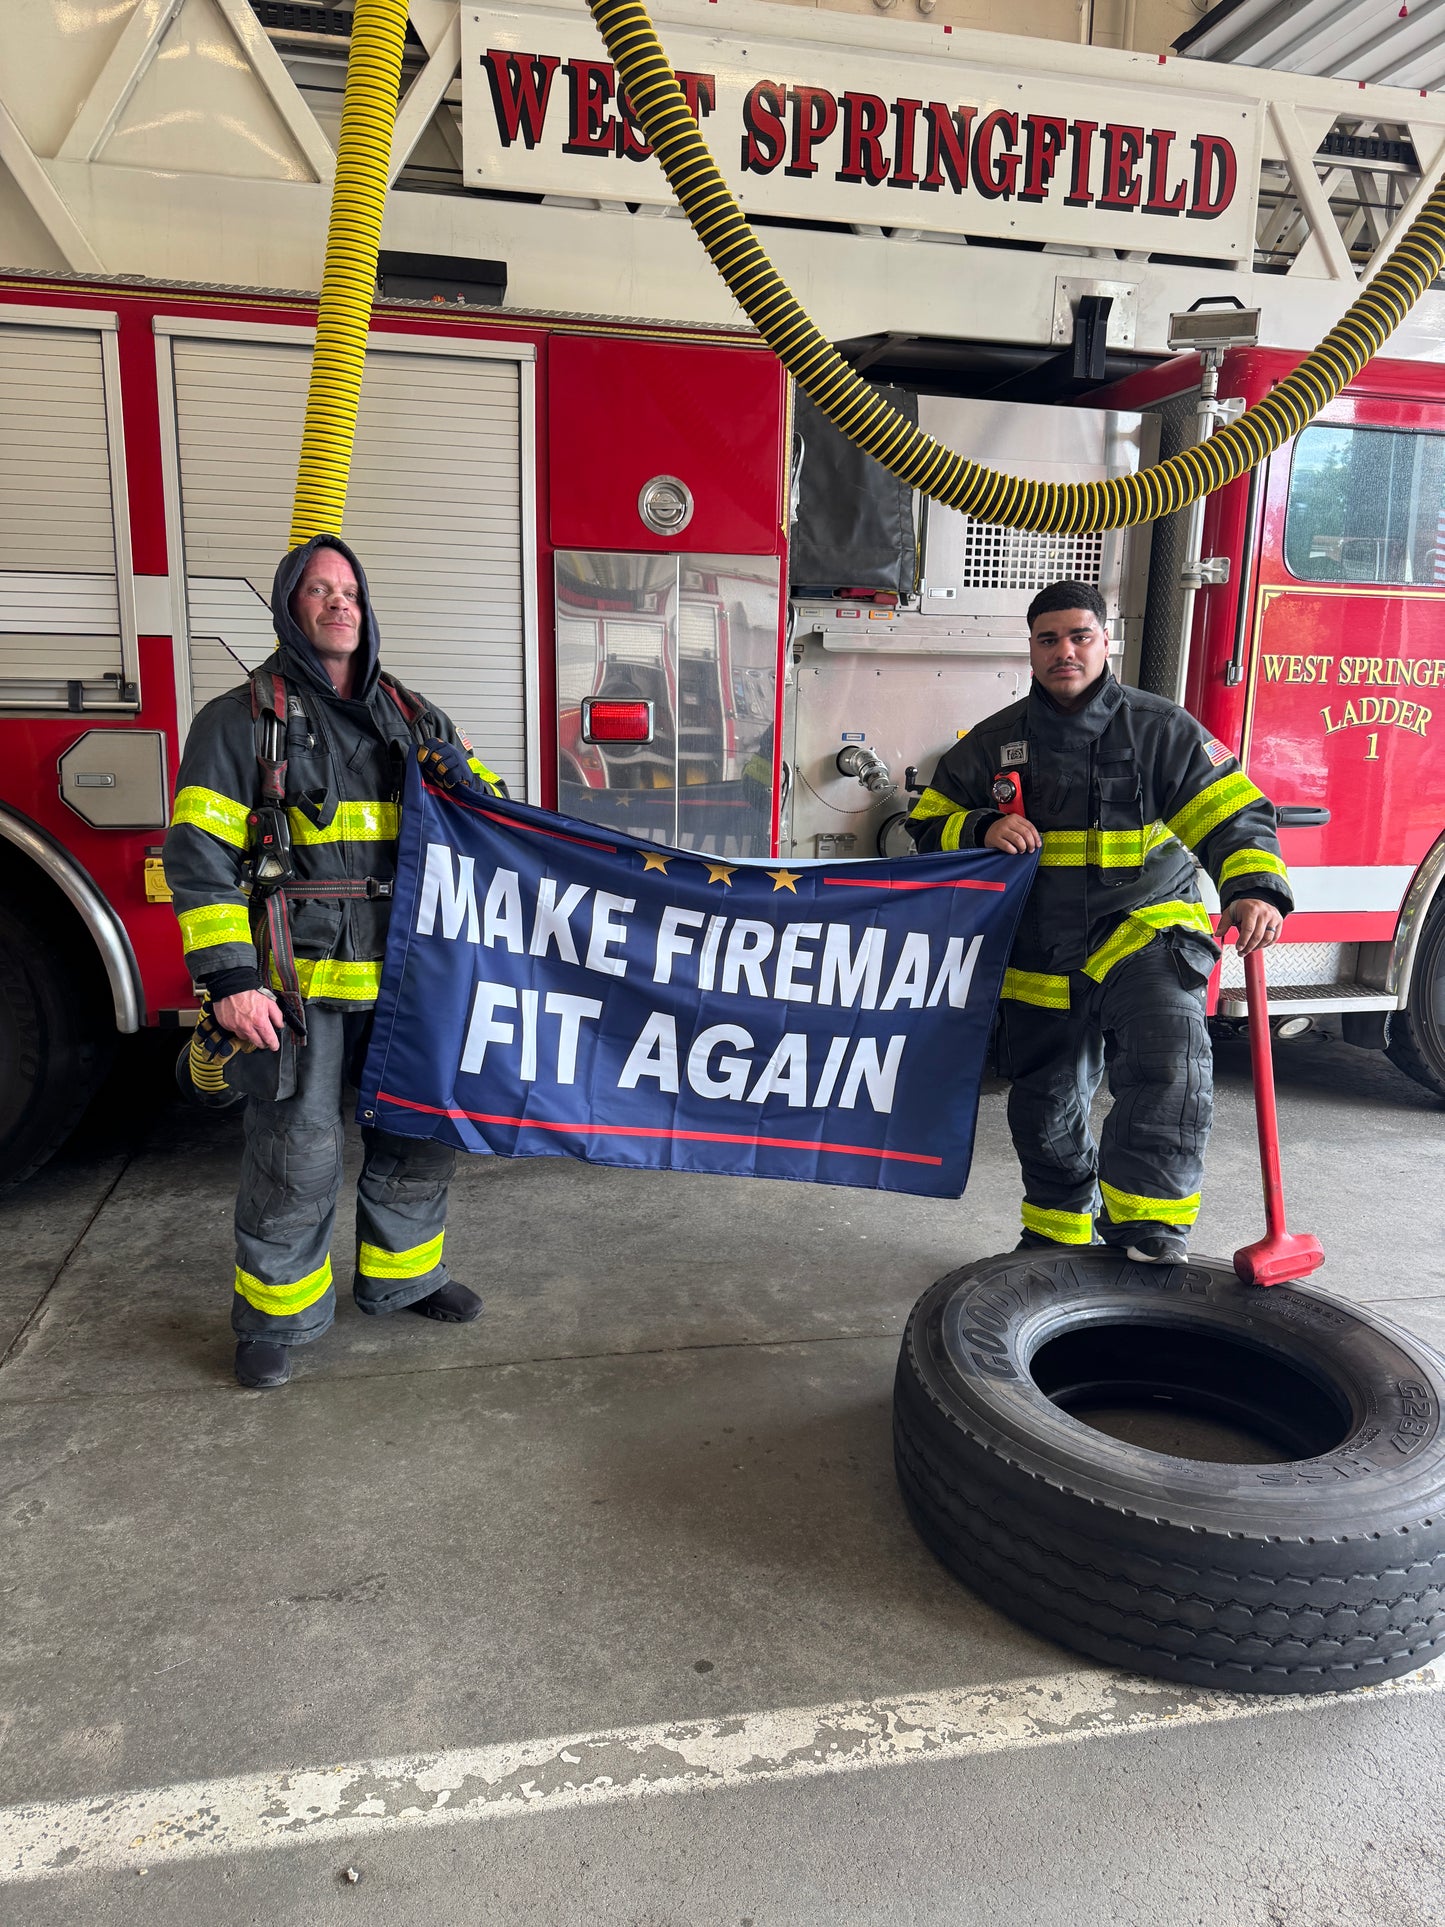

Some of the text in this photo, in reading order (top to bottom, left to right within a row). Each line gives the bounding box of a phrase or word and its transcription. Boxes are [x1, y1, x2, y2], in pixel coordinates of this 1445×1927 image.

[741, 78, 1238, 221] SPRINGFIELD
[1262, 654, 1333, 684] WEST
[1320, 696, 1433, 737] LADDER
[1363, 732, 1380, 761] 1
[416, 843, 984, 1011] MAKE FIREMAN
[460, 981, 907, 1114] FIT AGAIN
[963, 1260, 1217, 1379] GOODYEAR
[1391, 1379, 1432, 1455] G287
